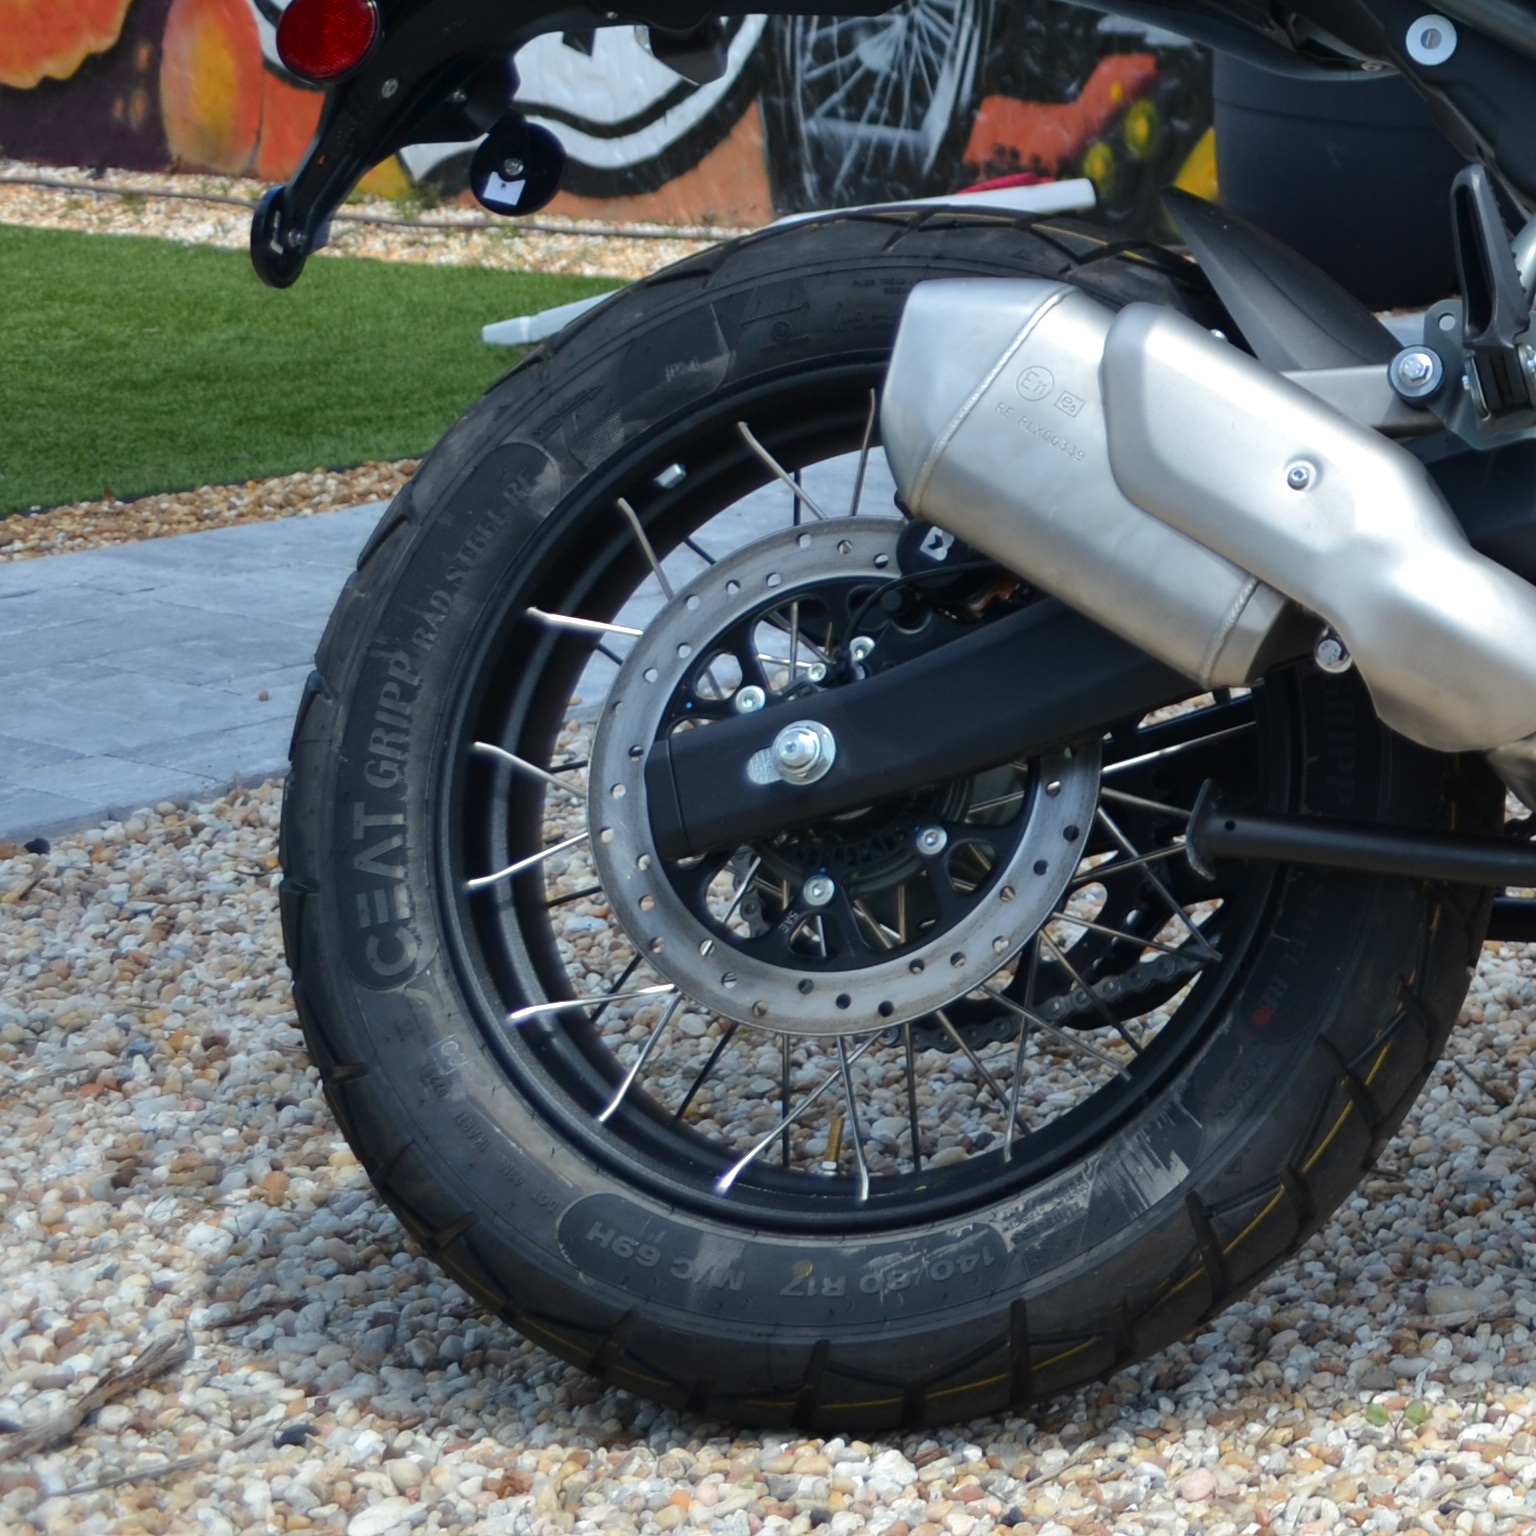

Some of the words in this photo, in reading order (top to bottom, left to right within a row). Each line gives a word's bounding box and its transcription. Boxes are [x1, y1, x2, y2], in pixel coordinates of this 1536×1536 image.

[362, 646, 429, 789] GRIPP
[350, 800, 425, 983] CEAT
[583, 1217, 663, 1272] 69H
[778, 1271, 846, 1298] R17
